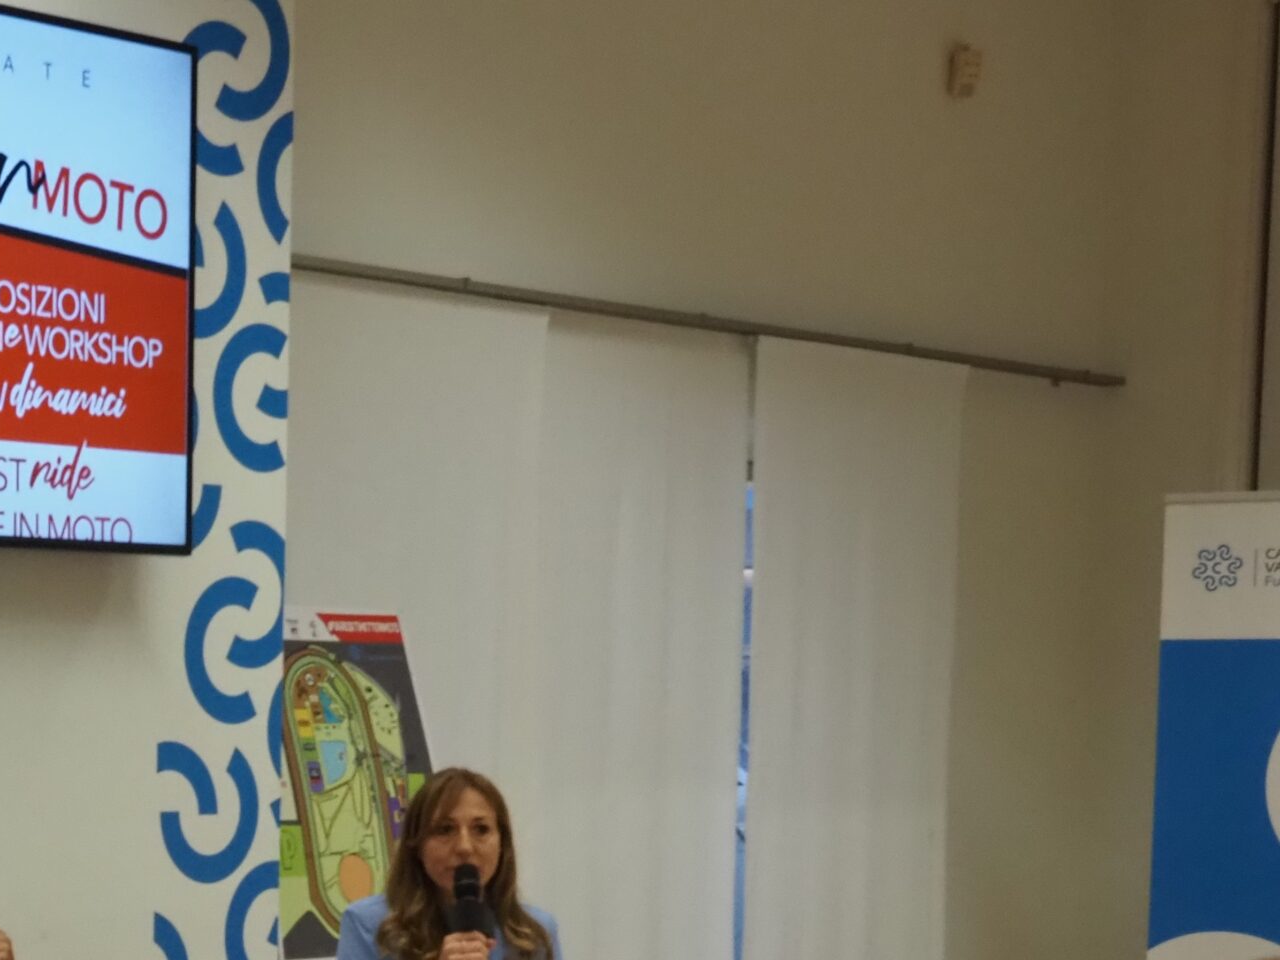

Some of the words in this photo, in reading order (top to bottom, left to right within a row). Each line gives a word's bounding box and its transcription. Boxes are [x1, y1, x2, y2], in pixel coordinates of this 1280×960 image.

[32, 160, 169, 240] MOTO
[23, 323, 163, 368] WORKSHOP
[10, 362, 127, 418] dinamici
[30, 439, 95, 500] ride
[48, 515, 133, 543] MOTO
